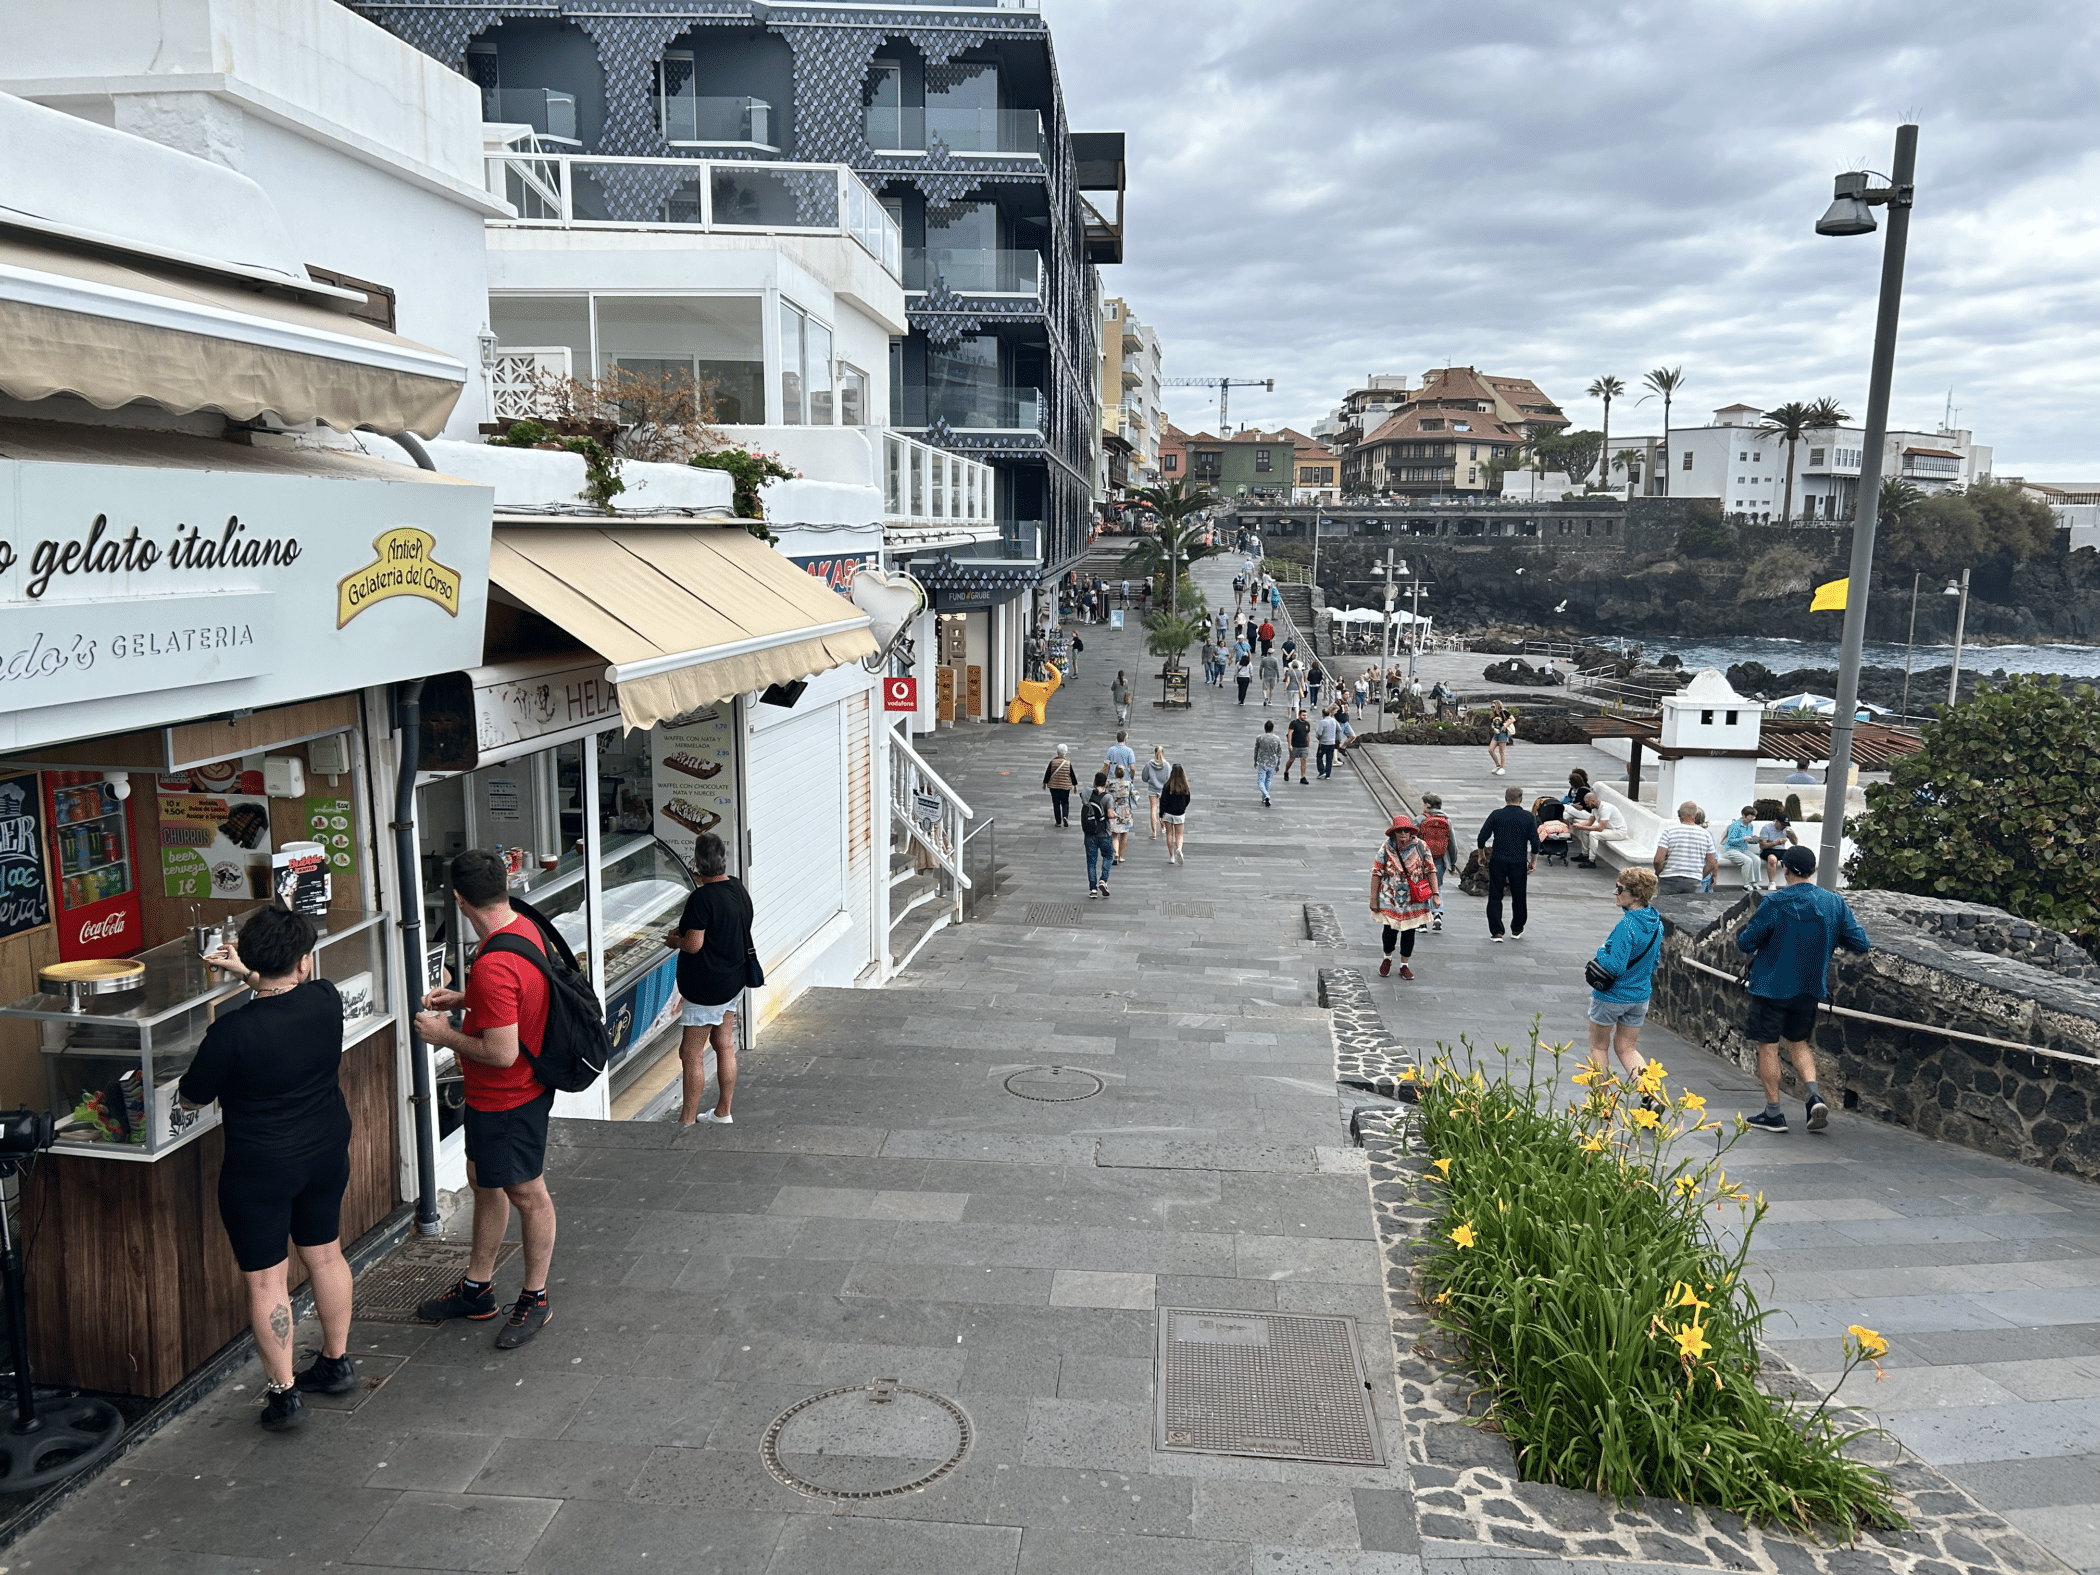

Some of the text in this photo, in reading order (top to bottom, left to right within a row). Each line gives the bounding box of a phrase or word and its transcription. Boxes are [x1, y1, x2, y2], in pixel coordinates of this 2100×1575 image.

[26, 513, 162, 598] gelato
[167, 515, 303, 570] italiano
[348, 564, 453, 605] Gelateria del Corso
[971, 590, 991, 600] GRUBE
[0, 624, 254, 681] do's GELATERIA
[565, 679, 620, 722] HELA
[163, 828, 210, 845] CHURROS
[164, 862, 208, 876] cerveza
[168, 850, 198, 863] beer
[178, 879, 197, 895] 1€
[79, 911, 126, 944] Coca-Cola
